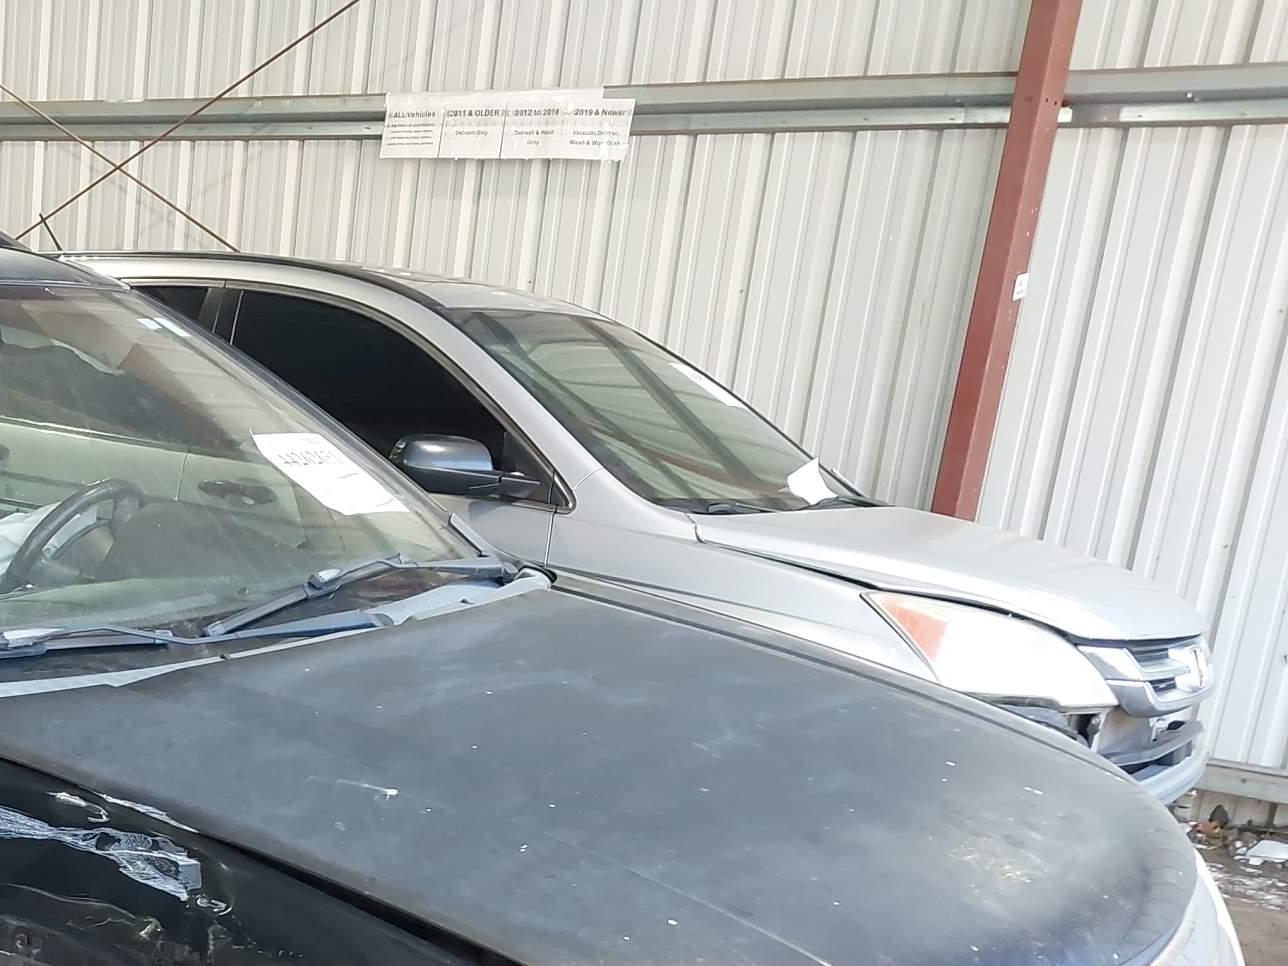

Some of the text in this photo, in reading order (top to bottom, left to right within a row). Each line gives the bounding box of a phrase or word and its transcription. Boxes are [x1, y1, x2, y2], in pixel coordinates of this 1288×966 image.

[393, 110, 436, 119] ALL Vehicles
[474, 109, 500, 117] OLDER
[574, 108, 593, 116] 2019
